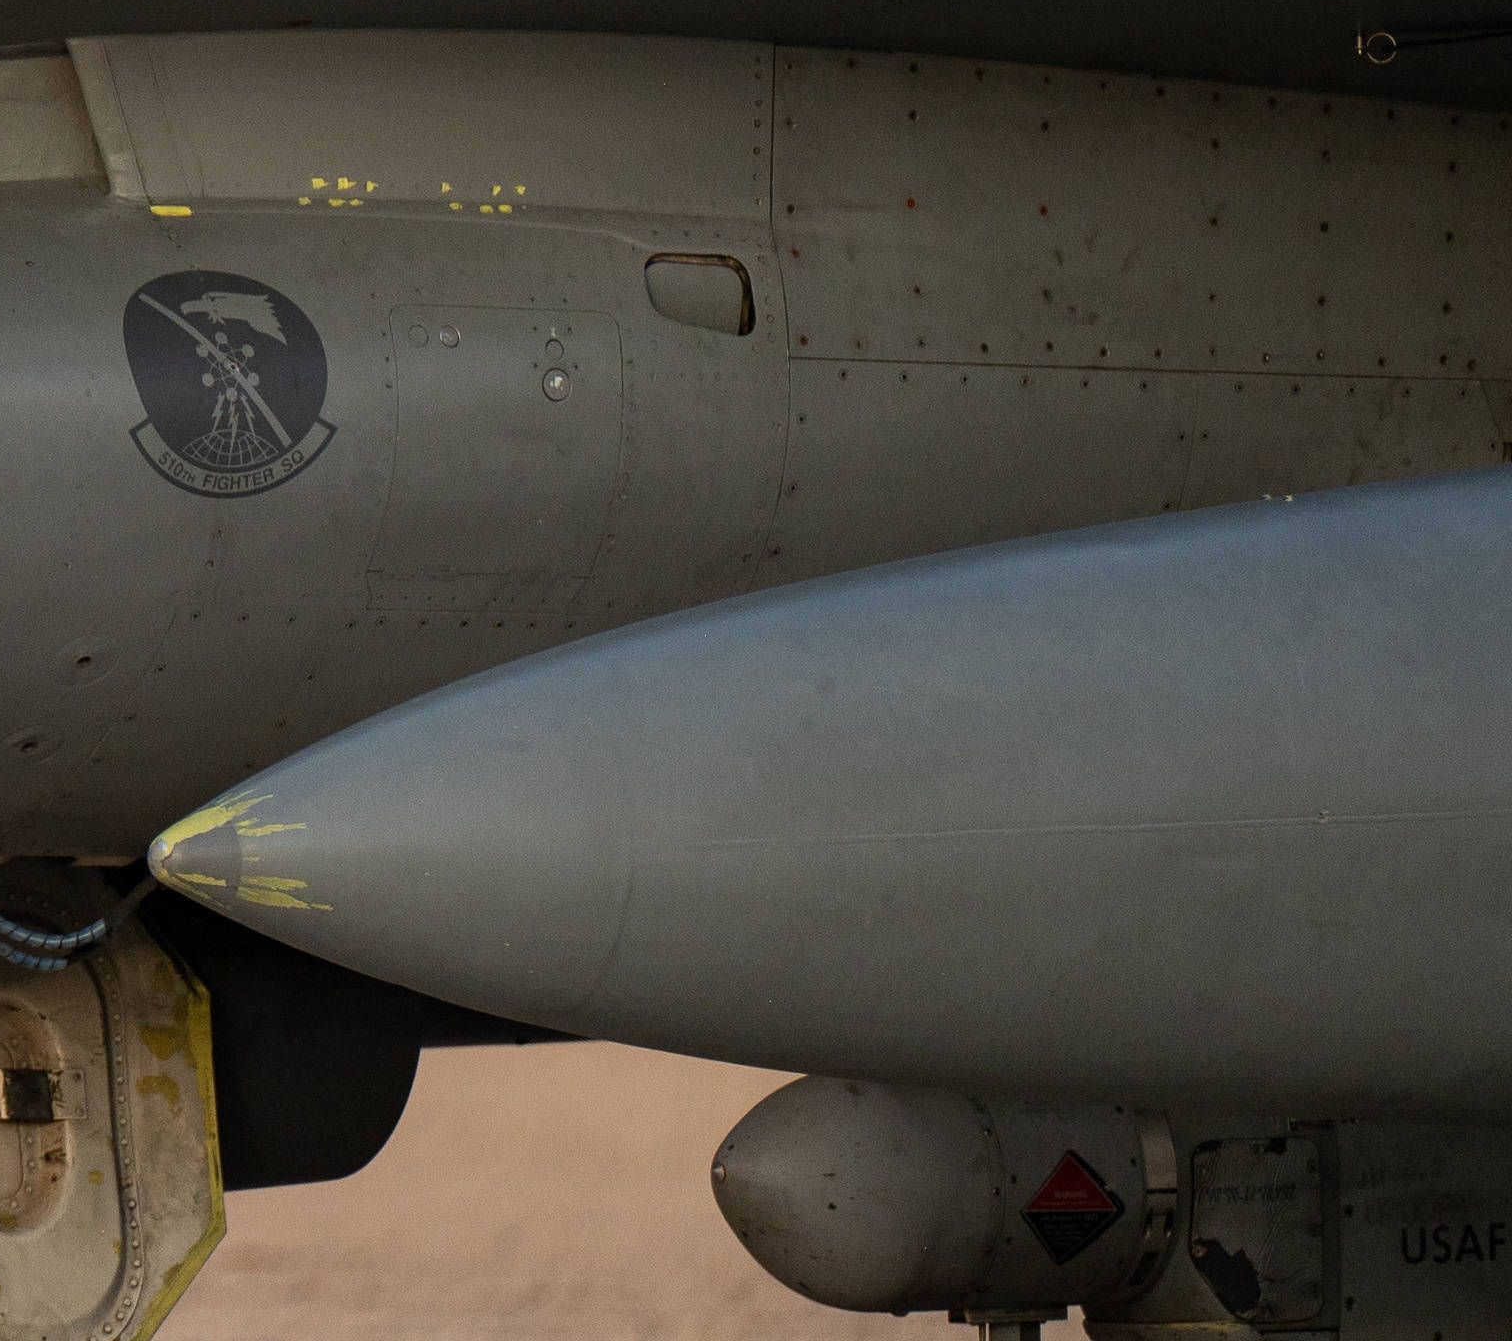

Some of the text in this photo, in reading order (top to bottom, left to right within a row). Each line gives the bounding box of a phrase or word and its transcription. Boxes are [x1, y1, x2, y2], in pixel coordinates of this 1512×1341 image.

[202, 467, 274, 490] FIGHTER
[281, 449, 304, 473] SQ
[1400, 1221, 1506, 1265] USAF
